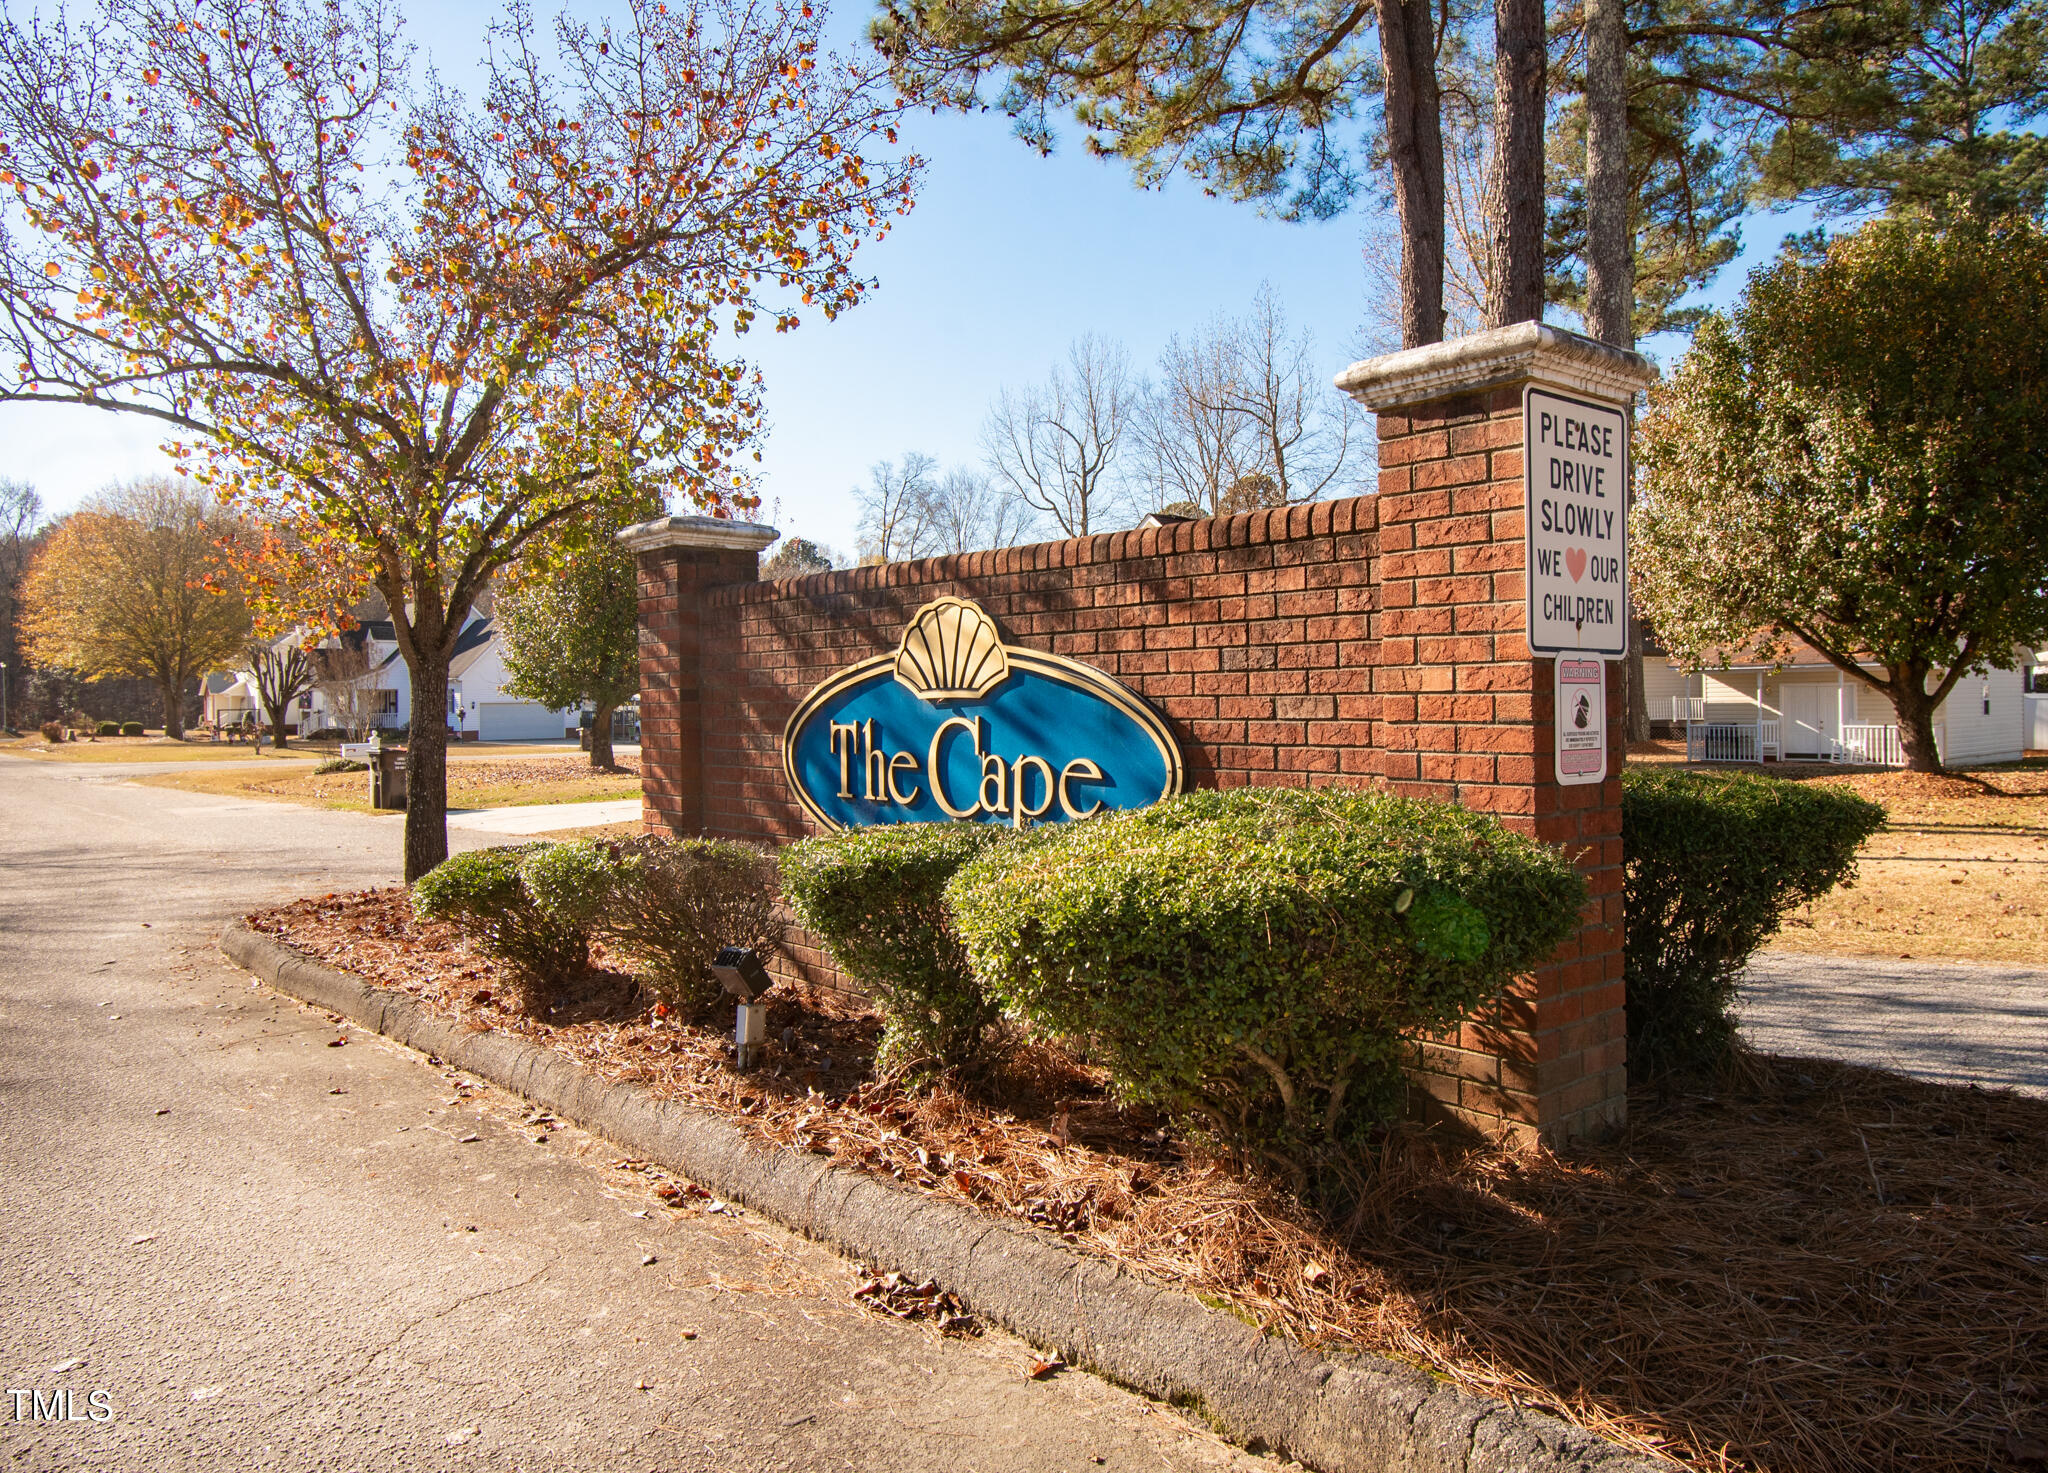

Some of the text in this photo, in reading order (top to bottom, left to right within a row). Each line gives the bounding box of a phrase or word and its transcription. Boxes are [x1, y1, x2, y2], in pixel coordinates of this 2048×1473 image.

[1541, 412, 1613, 458] PLEASE
[1550, 457, 1605, 498] DRIVE
[1541, 499, 1614, 540] SLOWLY
[1538, 548, 1619, 584] WE OUR
[1544, 593, 1614, 625] CHILDREN
[1563, 666, 1599, 679] WARNING
[830, 715, 1103, 829] The Cape
